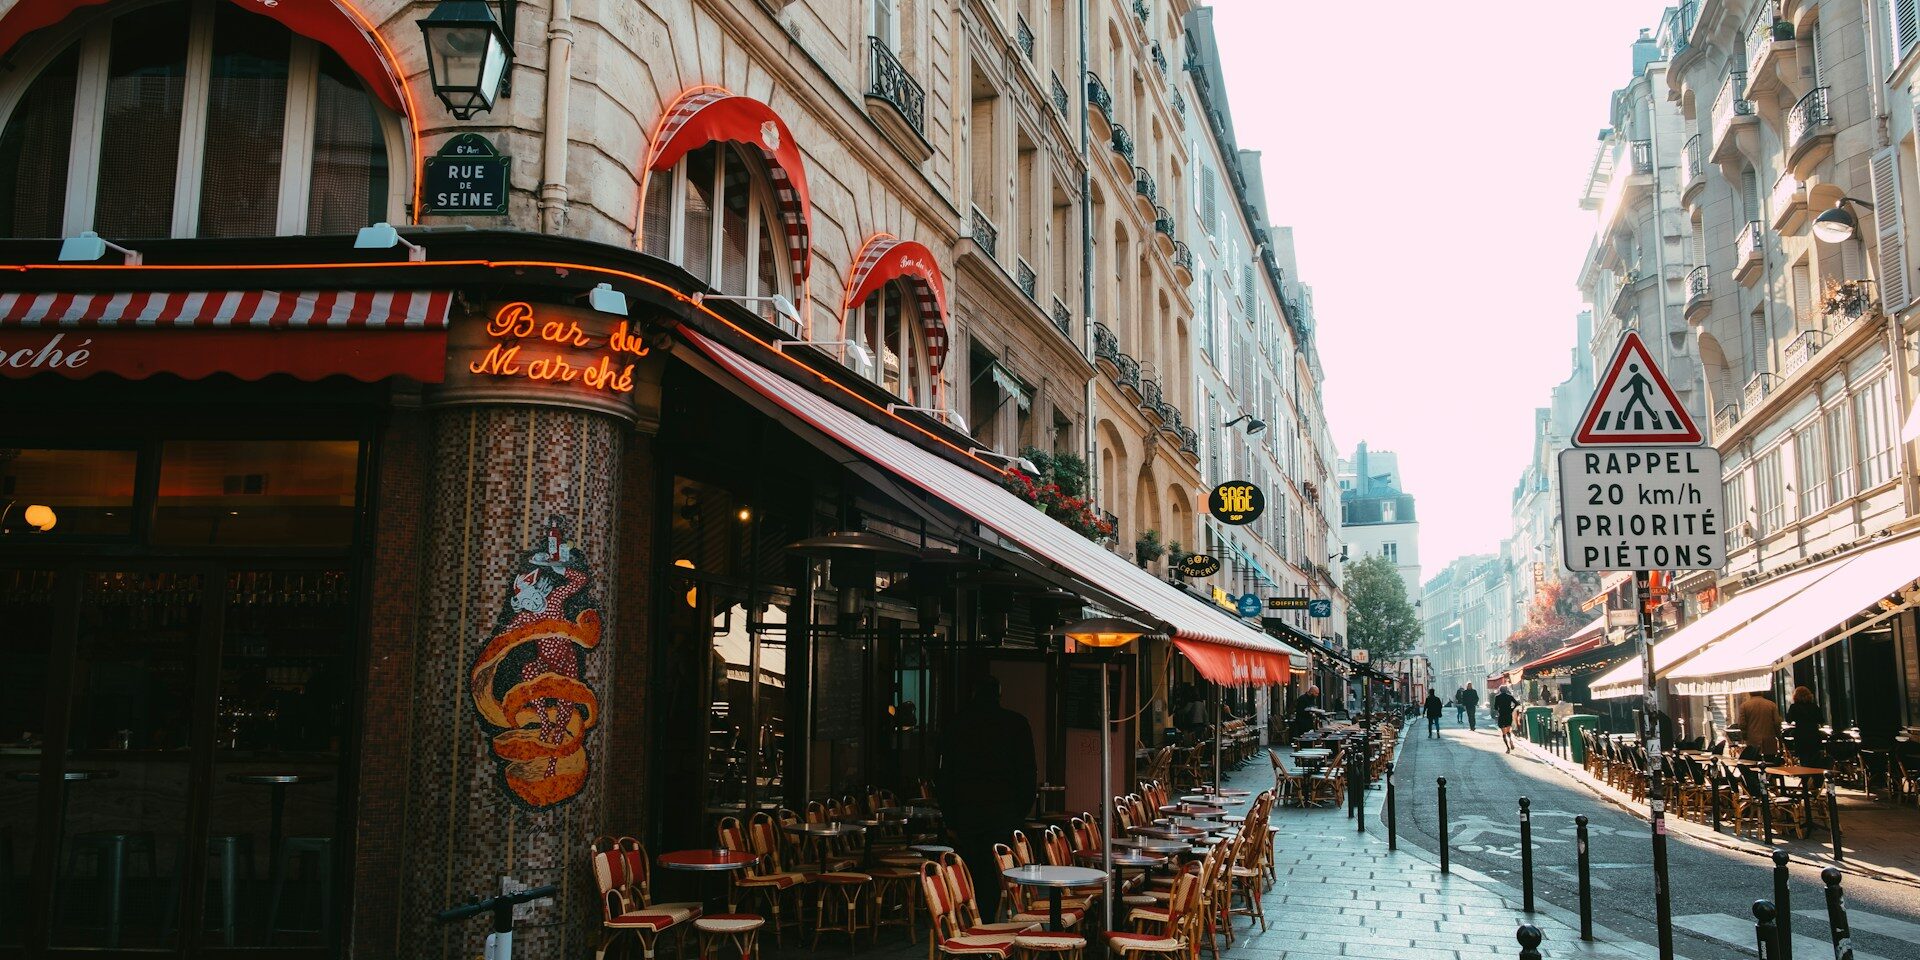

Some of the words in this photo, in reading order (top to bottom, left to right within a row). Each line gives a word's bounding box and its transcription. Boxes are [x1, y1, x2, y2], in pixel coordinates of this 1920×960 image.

[448, 165, 485, 179] RUE
[459, 182, 472, 190] DE
[437, 192, 493, 207] SEINE
[487, 301, 590, 346] Bar
[610, 319, 649, 356] du
[469, 344, 635, 392] Marché
[1585, 452, 1700, 474] RAPPEL
[1587, 484, 1624, 505] 20
[1638, 483, 1702, 505] km/h
[1576, 509, 1716, 536] PRIORITÉ
[1584, 541, 1712, 568] PIÉTONS
